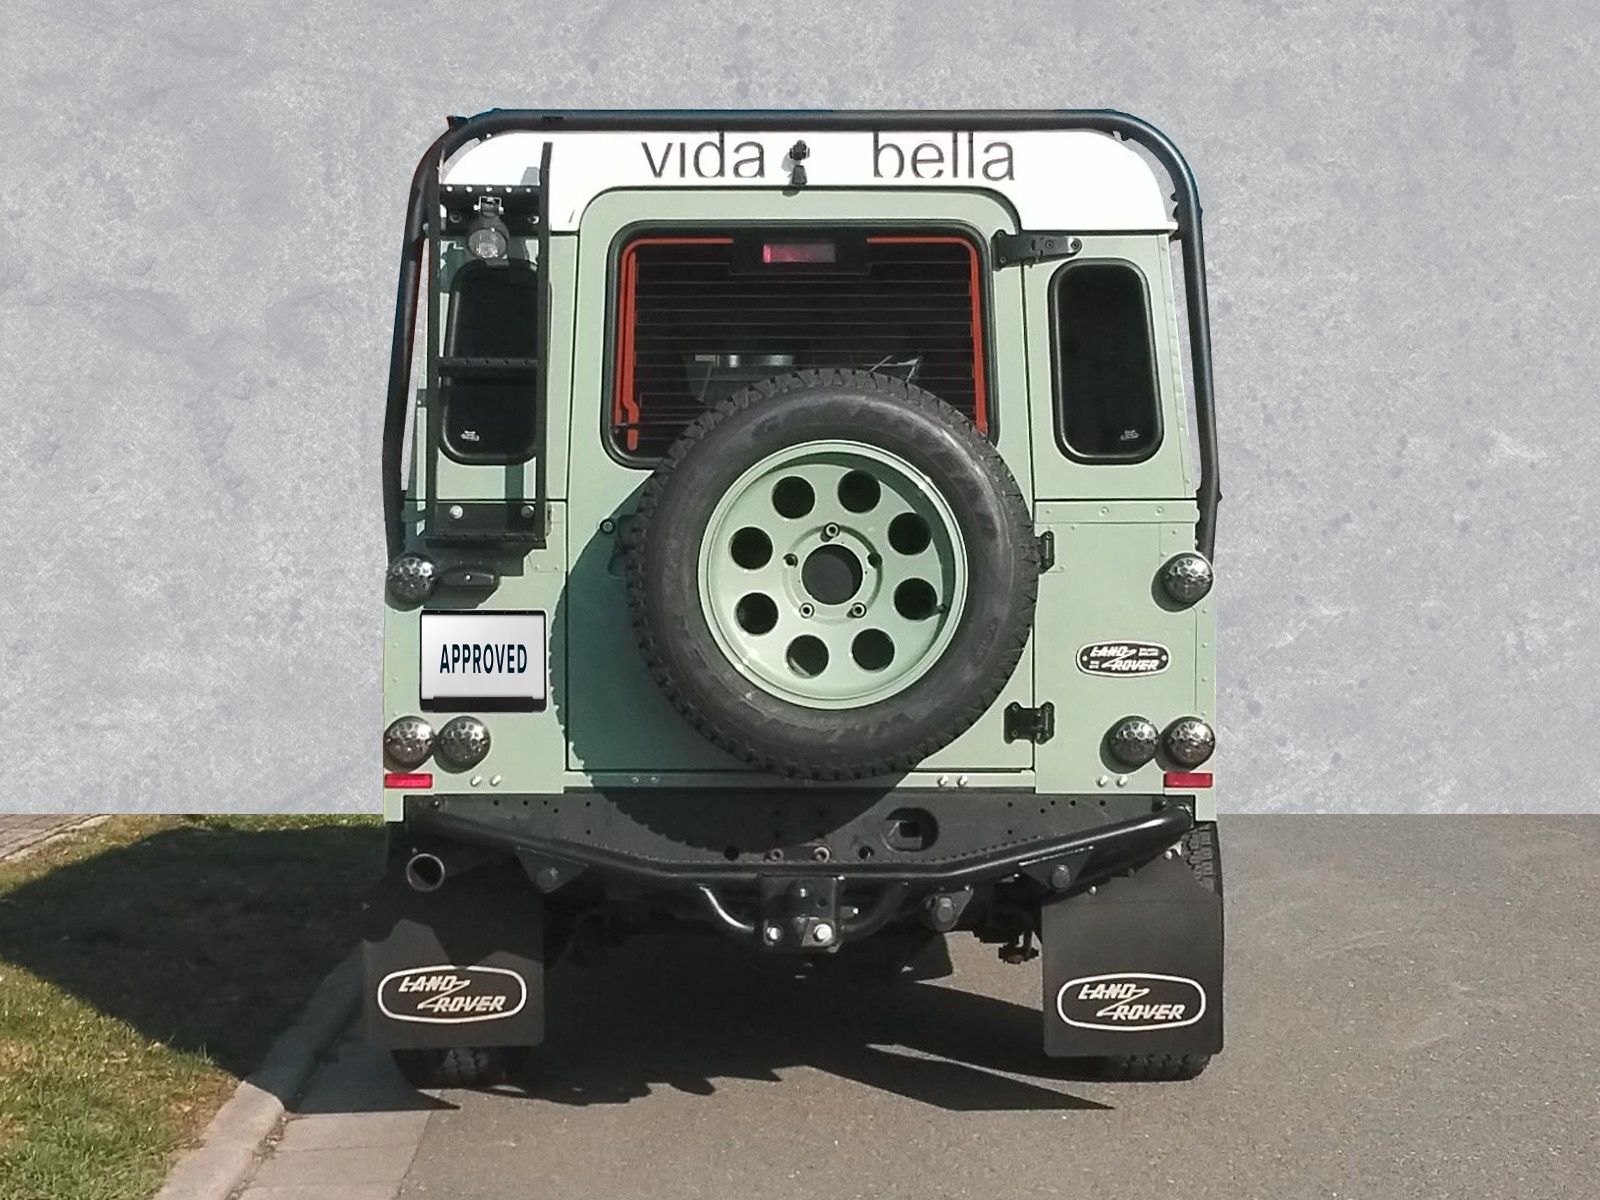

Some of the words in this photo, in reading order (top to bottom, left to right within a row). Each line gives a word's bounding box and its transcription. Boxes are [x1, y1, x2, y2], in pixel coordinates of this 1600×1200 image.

[641, 131, 765, 179] vida
[873, 130, 1015, 181] bella
[440, 643, 528, 674] APPROVED
[1090, 645, 1128, 657] LAND
[1109, 659, 1159, 671] ROVER
[398, 975, 457, 993] LAND
[1078, 983, 1136, 1000] LAND
[433, 995, 506, 1012] ROVER
[1112, 1004, 1186, 1020] ROVER
